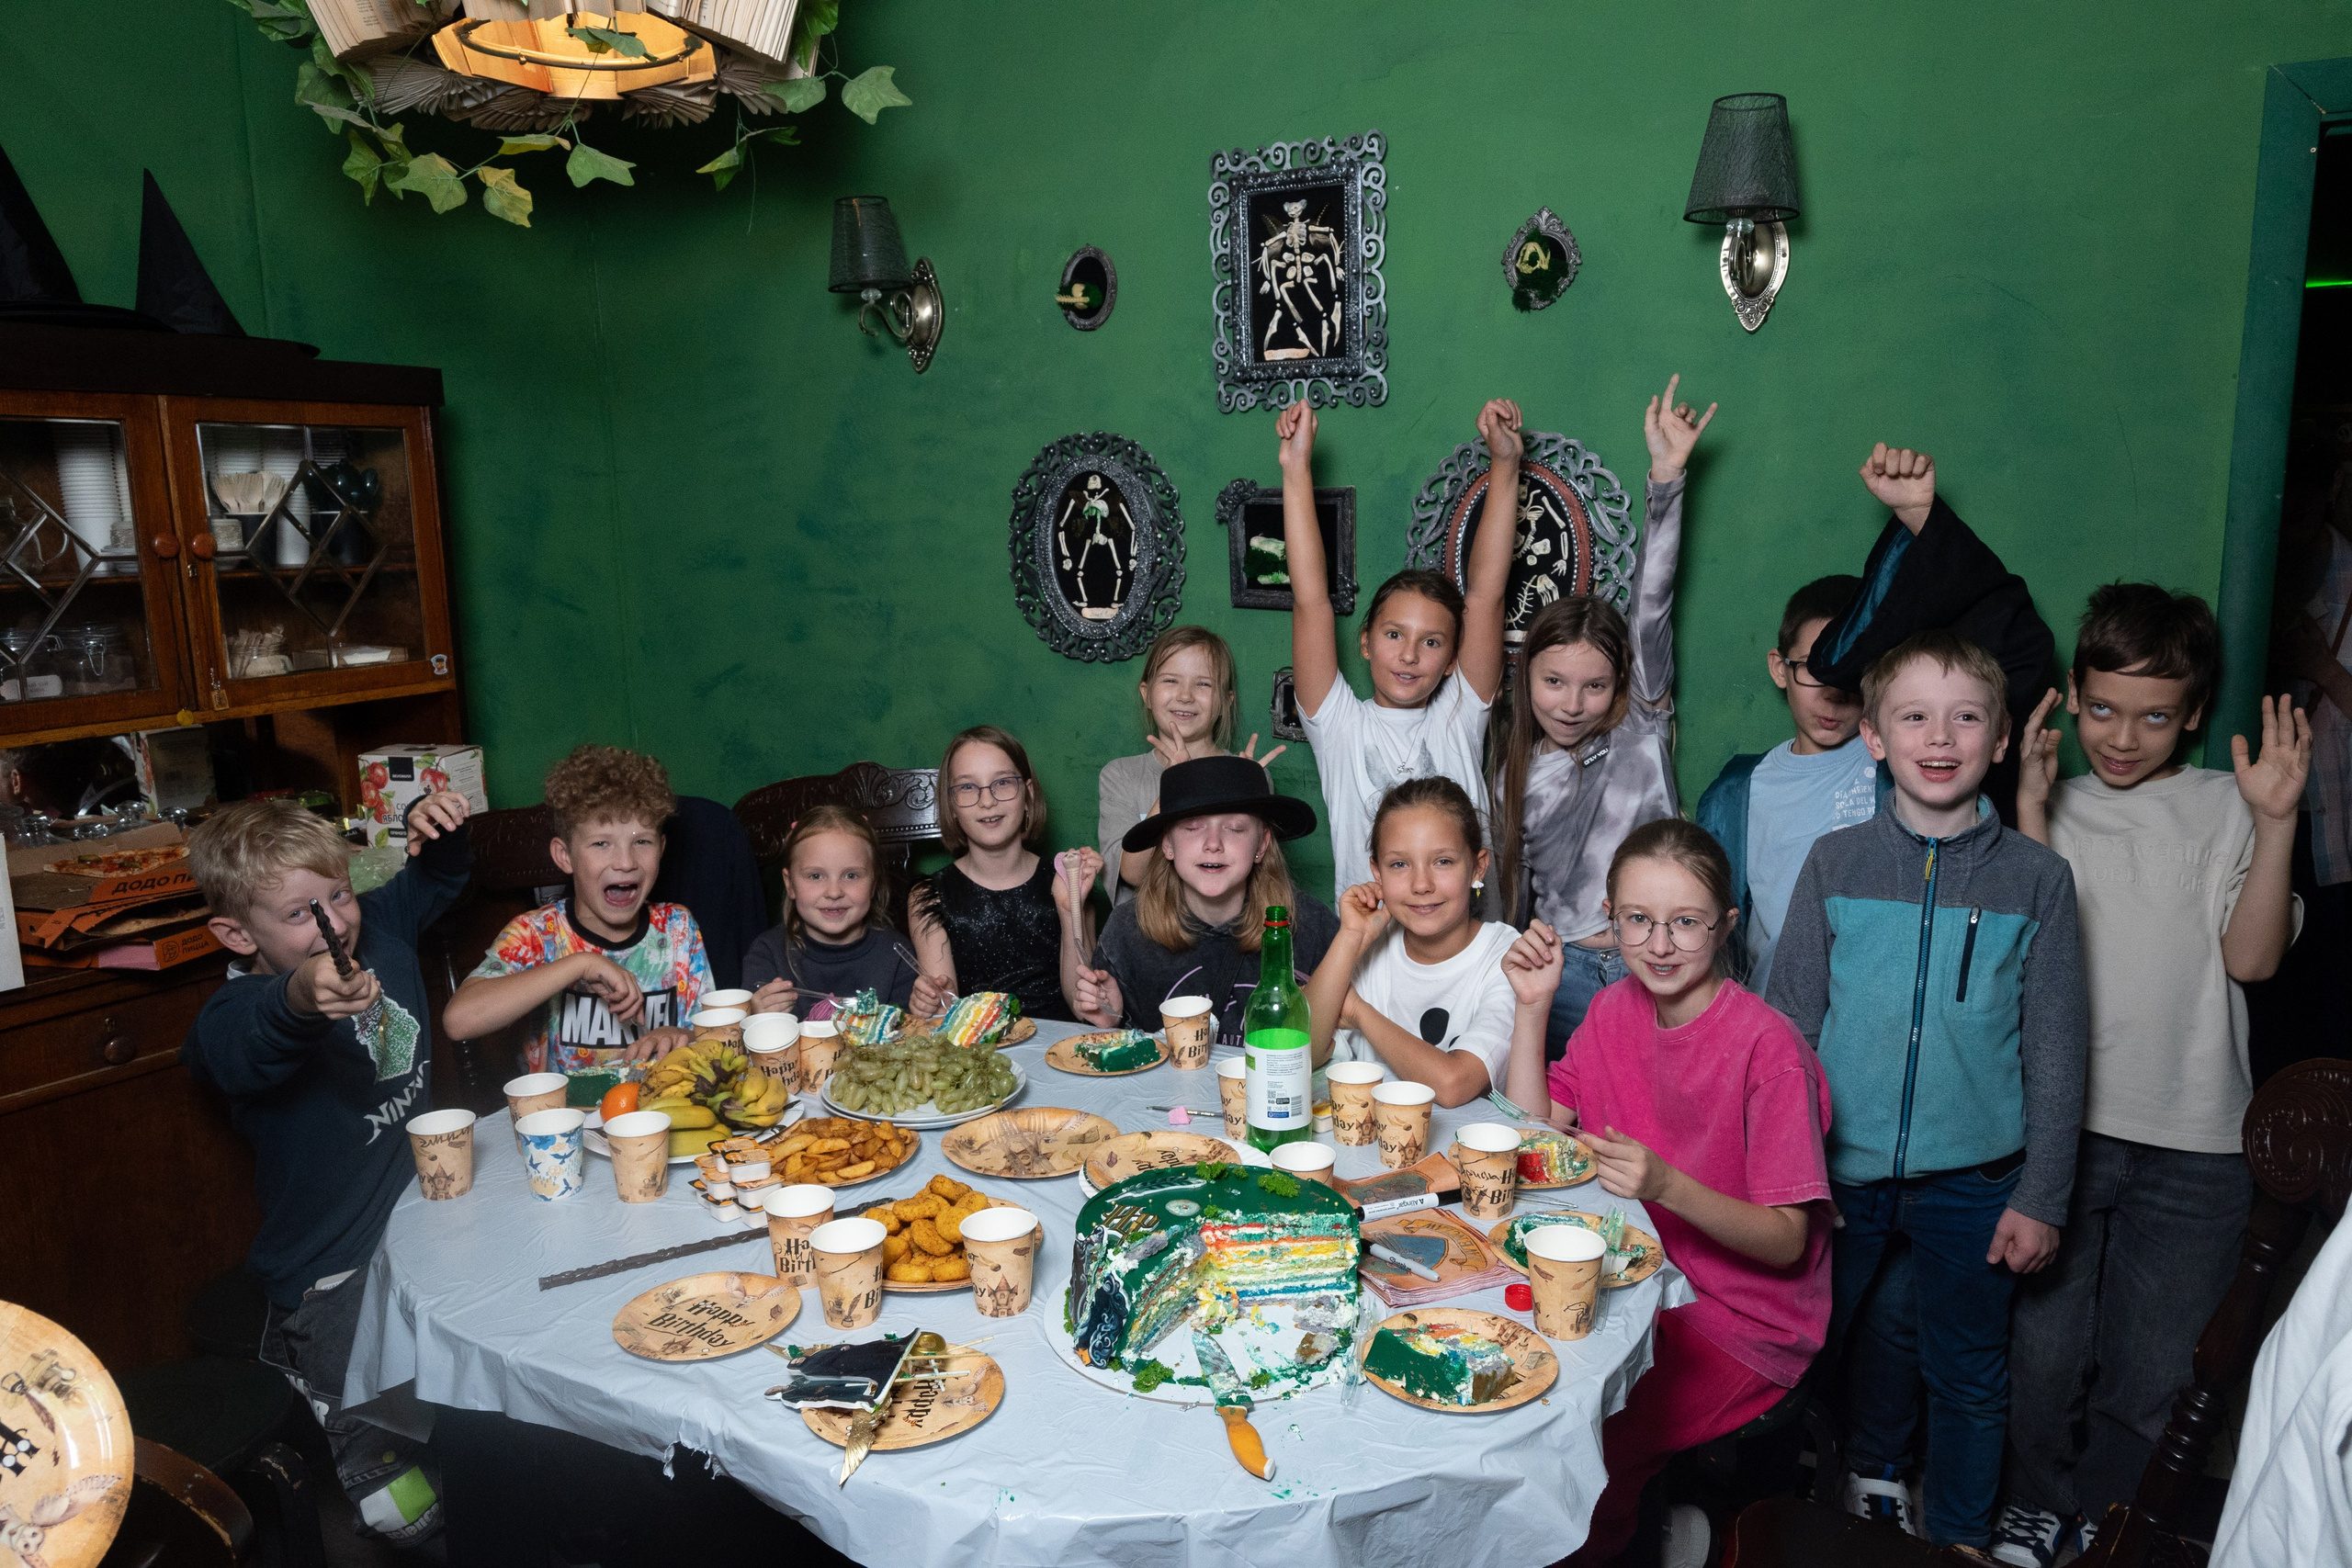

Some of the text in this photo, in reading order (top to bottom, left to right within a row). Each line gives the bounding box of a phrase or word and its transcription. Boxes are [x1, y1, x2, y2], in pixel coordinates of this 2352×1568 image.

[1583, 747, 1609, 765] ONLY YOU
[1856, 796, 1869, 806] DEL
[1842, 807, 1866, 818] TENGO
[2061, 837, 2229, 867] DISCOVERING
[111, 874, 170, 897] ДОДО
[181, 932, 204, 945] ДОДО
[181, 939, 210, 955] ПИЦЦА
[1222, 1033, 1245, 1047] AUT
[1396, 1199, 1419, 1210] Alingar
[685, 1299, 755, 1328] Happy
[647, 1313, 736, 1348] Birthday
